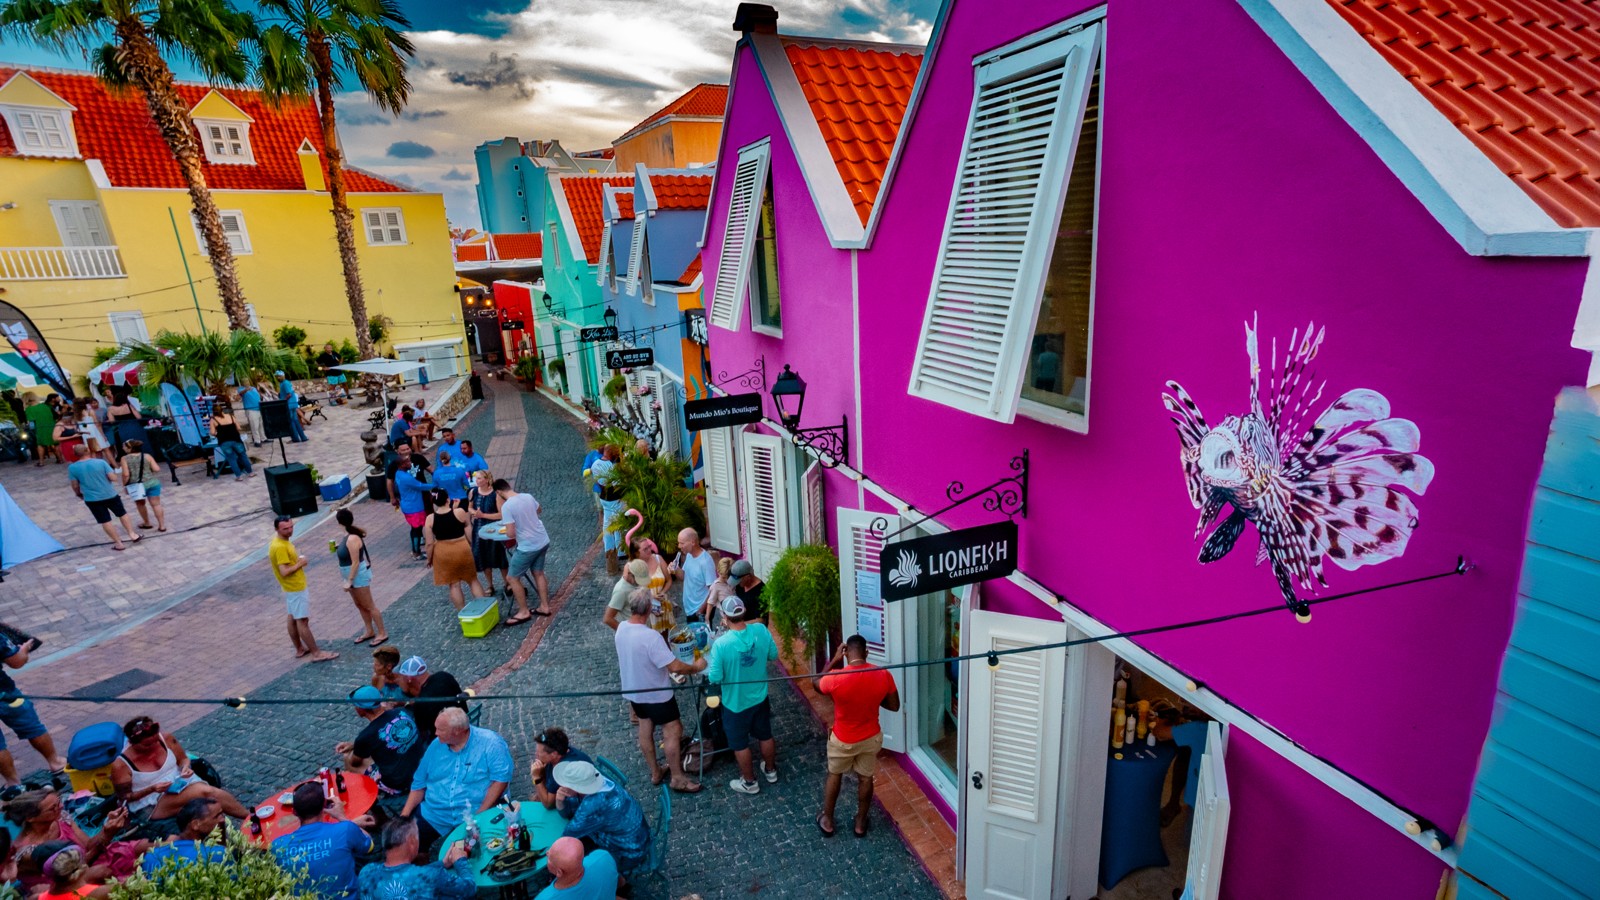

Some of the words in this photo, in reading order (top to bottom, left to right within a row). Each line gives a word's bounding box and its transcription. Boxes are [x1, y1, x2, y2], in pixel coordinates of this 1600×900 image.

[689, 410, 713, 420] Mundo
[713, 408, 731, 417] Mio's
[731, 405, 759, 415] Boutique
[929, 540, 1008, 576] LIONFISH
[949, 563, 989, 579] CARIBBEAN
